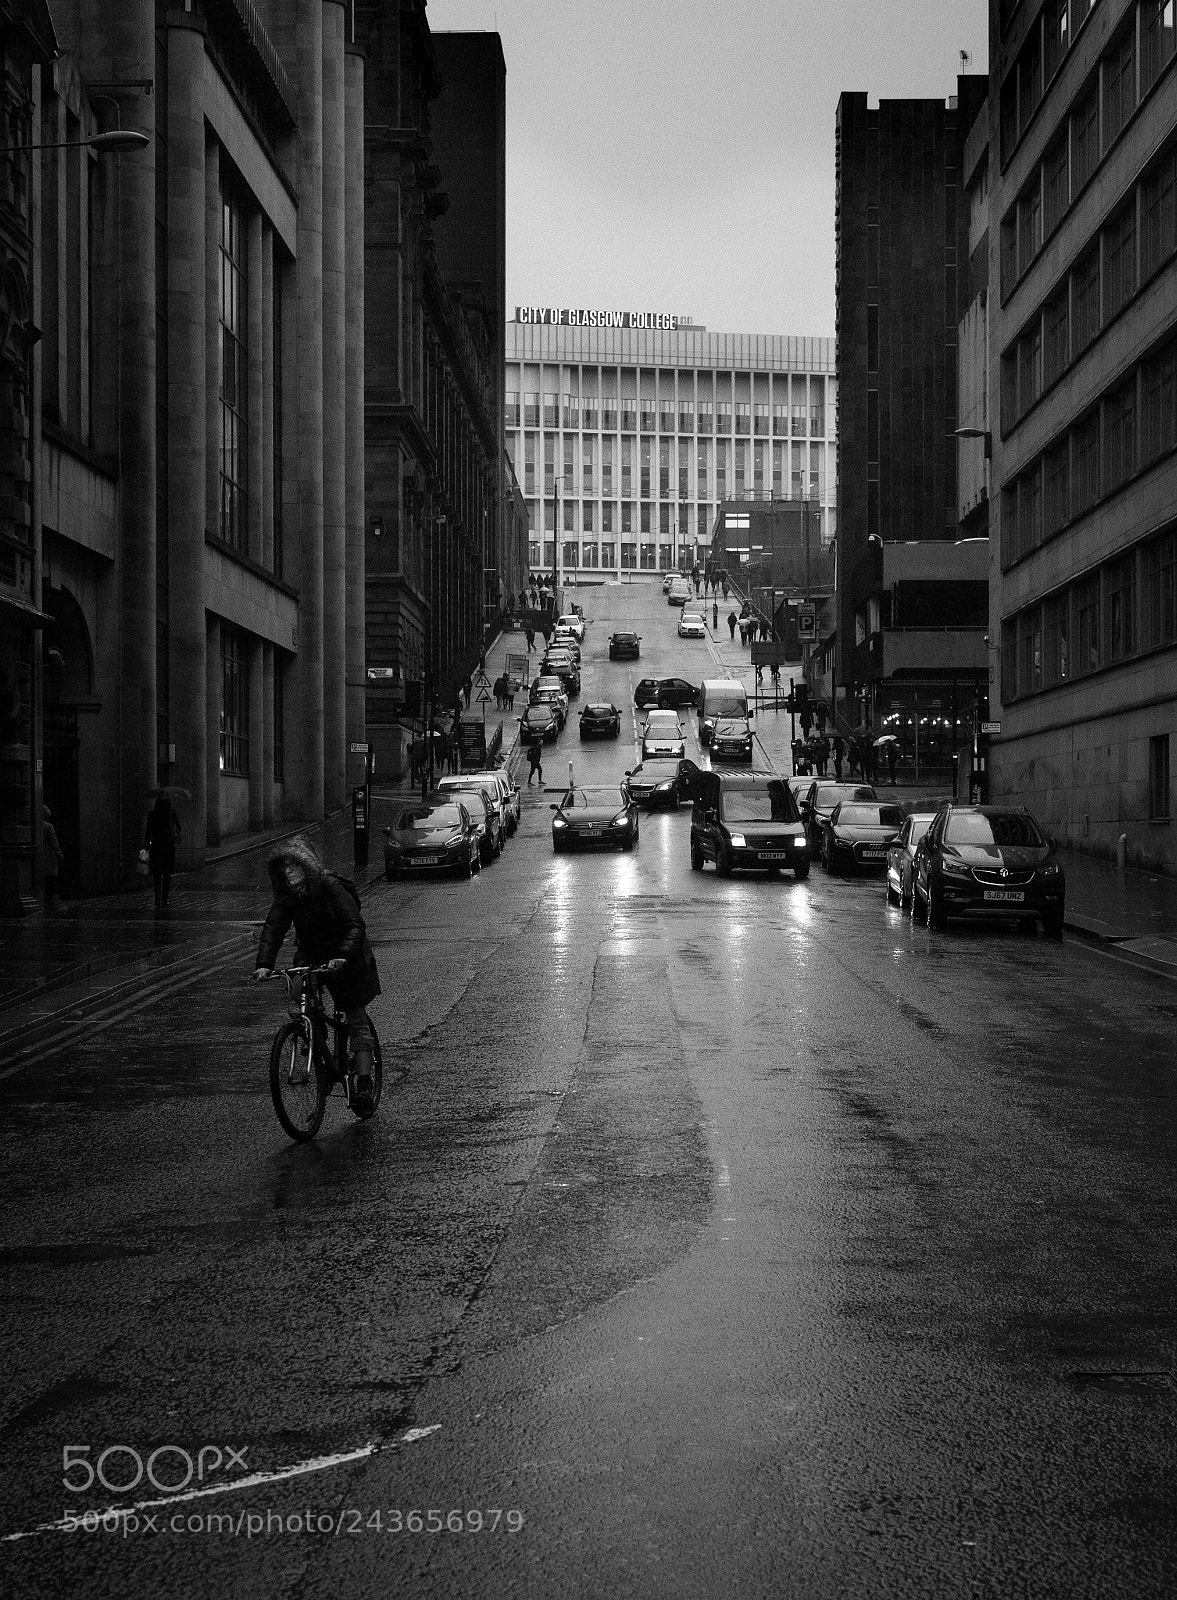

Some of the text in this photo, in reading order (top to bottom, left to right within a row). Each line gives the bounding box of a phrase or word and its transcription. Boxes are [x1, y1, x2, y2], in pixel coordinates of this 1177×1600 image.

[519, 306, 676, 330] CITY OF GLASGOW COLLEGE
[801, 616, 812, 630] P
